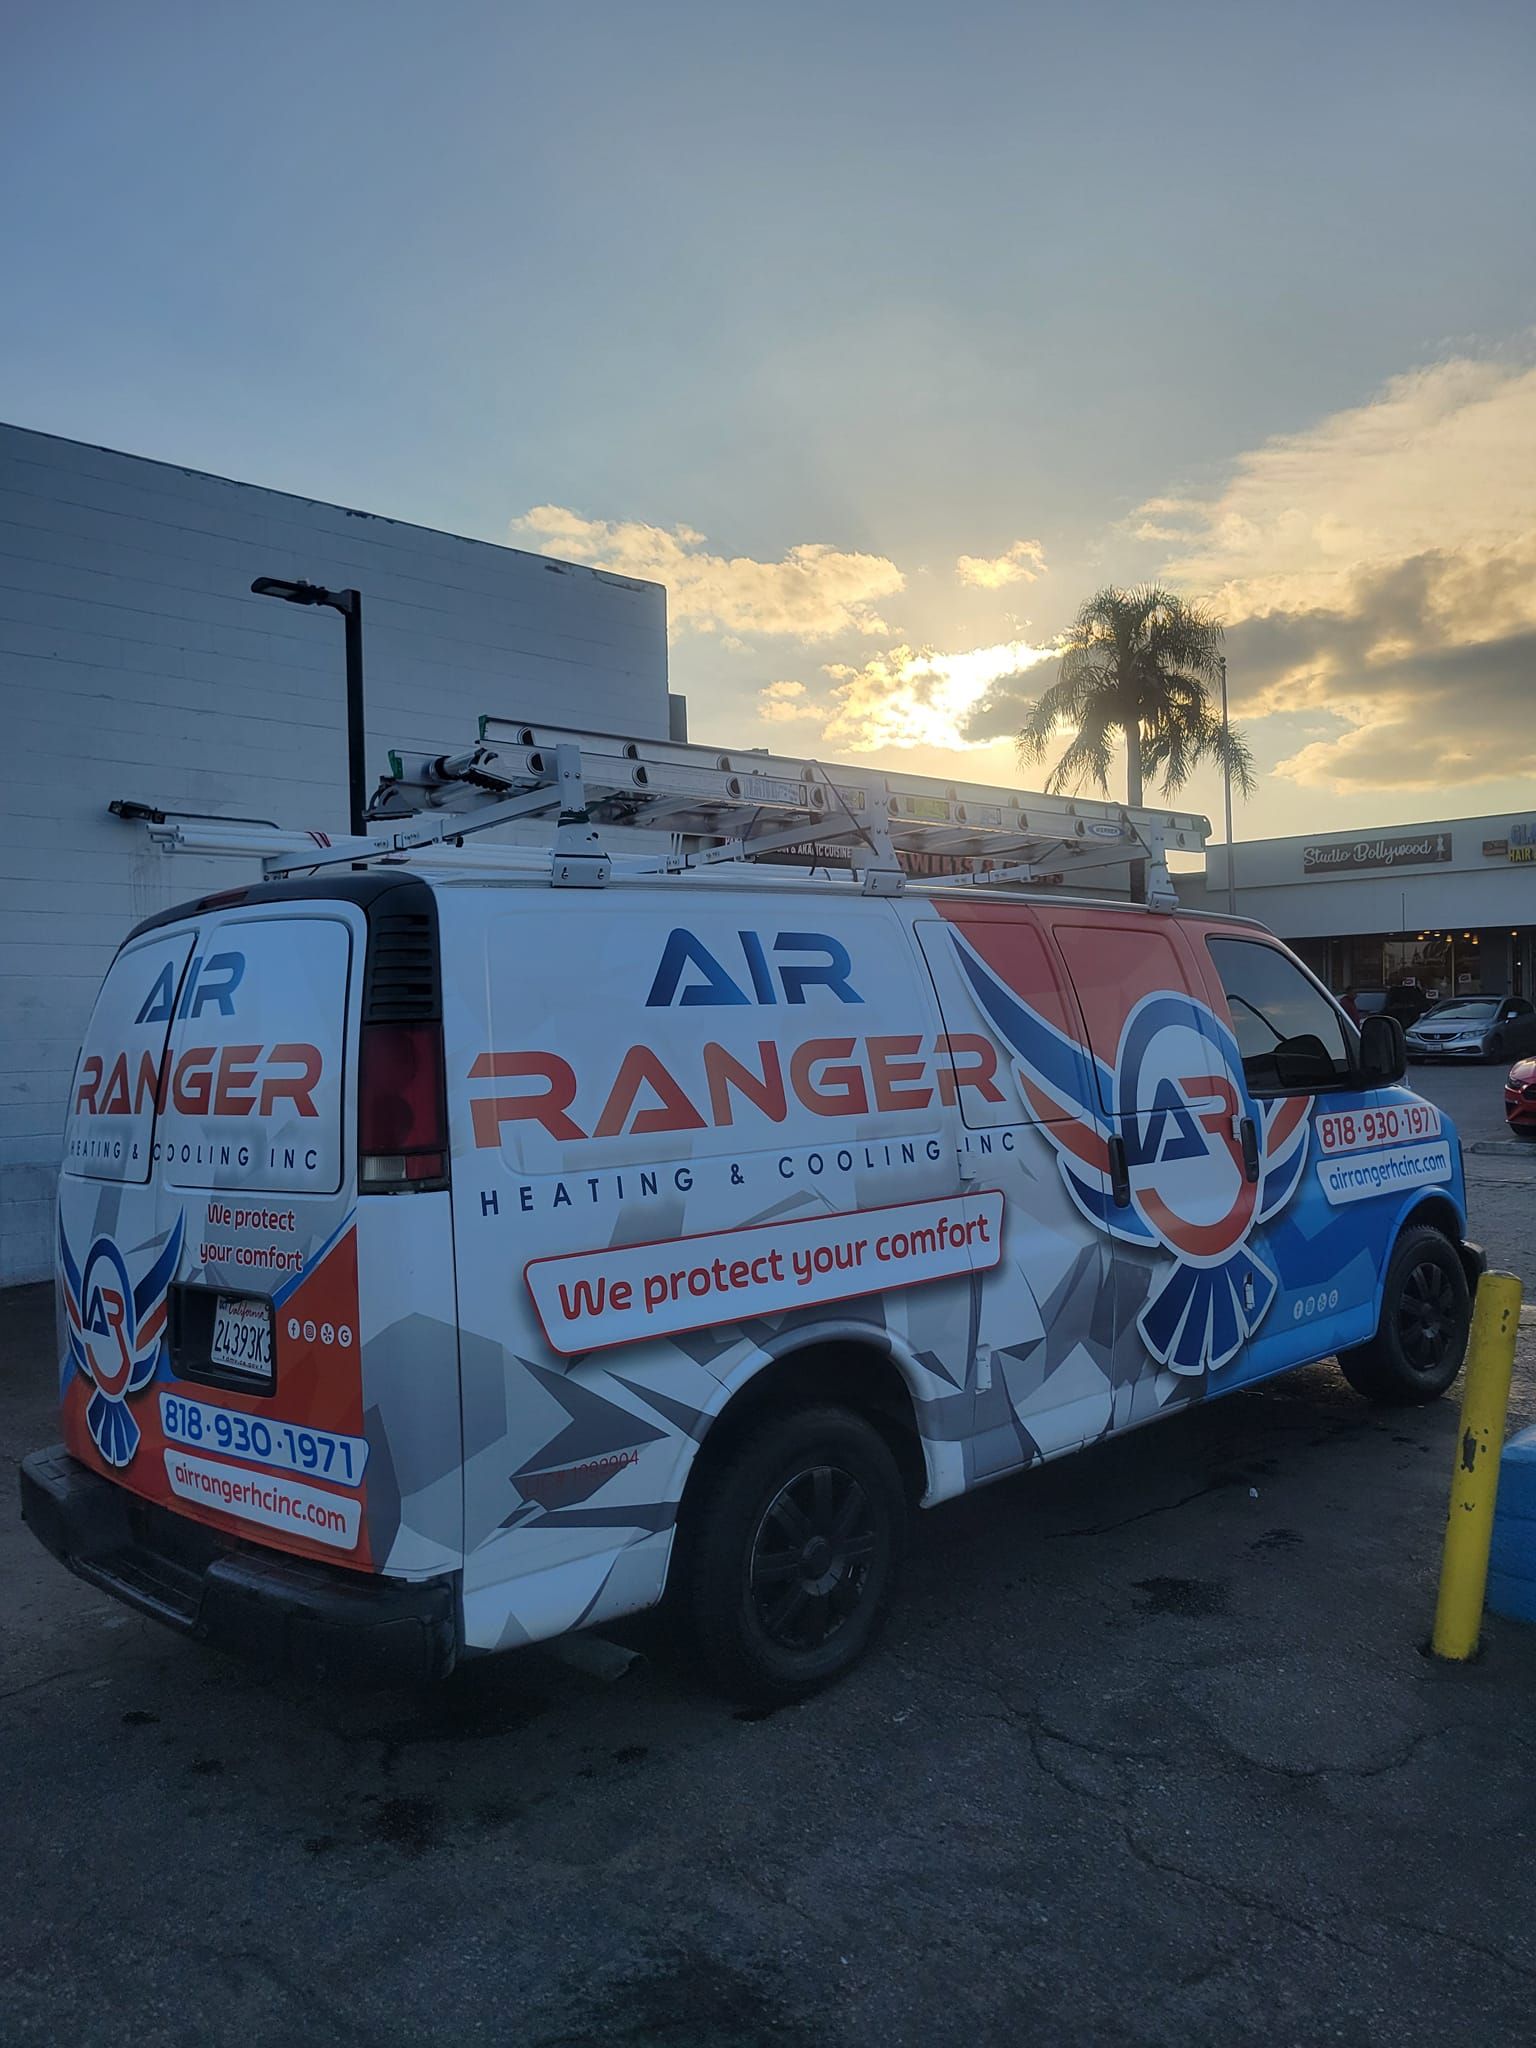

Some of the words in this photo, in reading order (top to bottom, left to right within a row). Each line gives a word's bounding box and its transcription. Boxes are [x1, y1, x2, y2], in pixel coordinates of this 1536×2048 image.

[825, 846, 852, 859] CUISINE
[1304, 848, 1350, 866] Studio
[1353, 840, 1432, 865] Bollywood
[1509, 848, 1532, 862] HAIR
[134, 952, 246, 1025] AIR
[645, 928, 865, 1007] AIR
[75, 1043, 323, 1117] RANGER
[467, 1033, 1007, 1148] RANGER
[70, 1139, 121, 1160] HEATING
[132, 1147, 140, 1160] &
[152, 1143, 249, 1166] COOLING
[270, 1148, 318, 1169] INC
[481, 1167, 695, 1217] HEATING
[730, 1164, 745, 1185] &
[778, 1141, 941, 1179] COOLING
[965, 1132, 1016, 1154] INC
[1328, 1152, 1447, 1195] airrangerhcinc.com
[207, 1203, 232, 1227] We
[234, 1208, 296, 1232] protect
[200, 1243, 233, 1266] your
[235, 1248, 303, 1272] comfort
[558, 1277, 633, 1321] We
[645, 1249, 783, 1313] protect
[791, 1239, 868, 1286] your
[875, 1213, 990, 1262] comfort
[175, 1461, 347, 1534] airrangerhcinc.com
